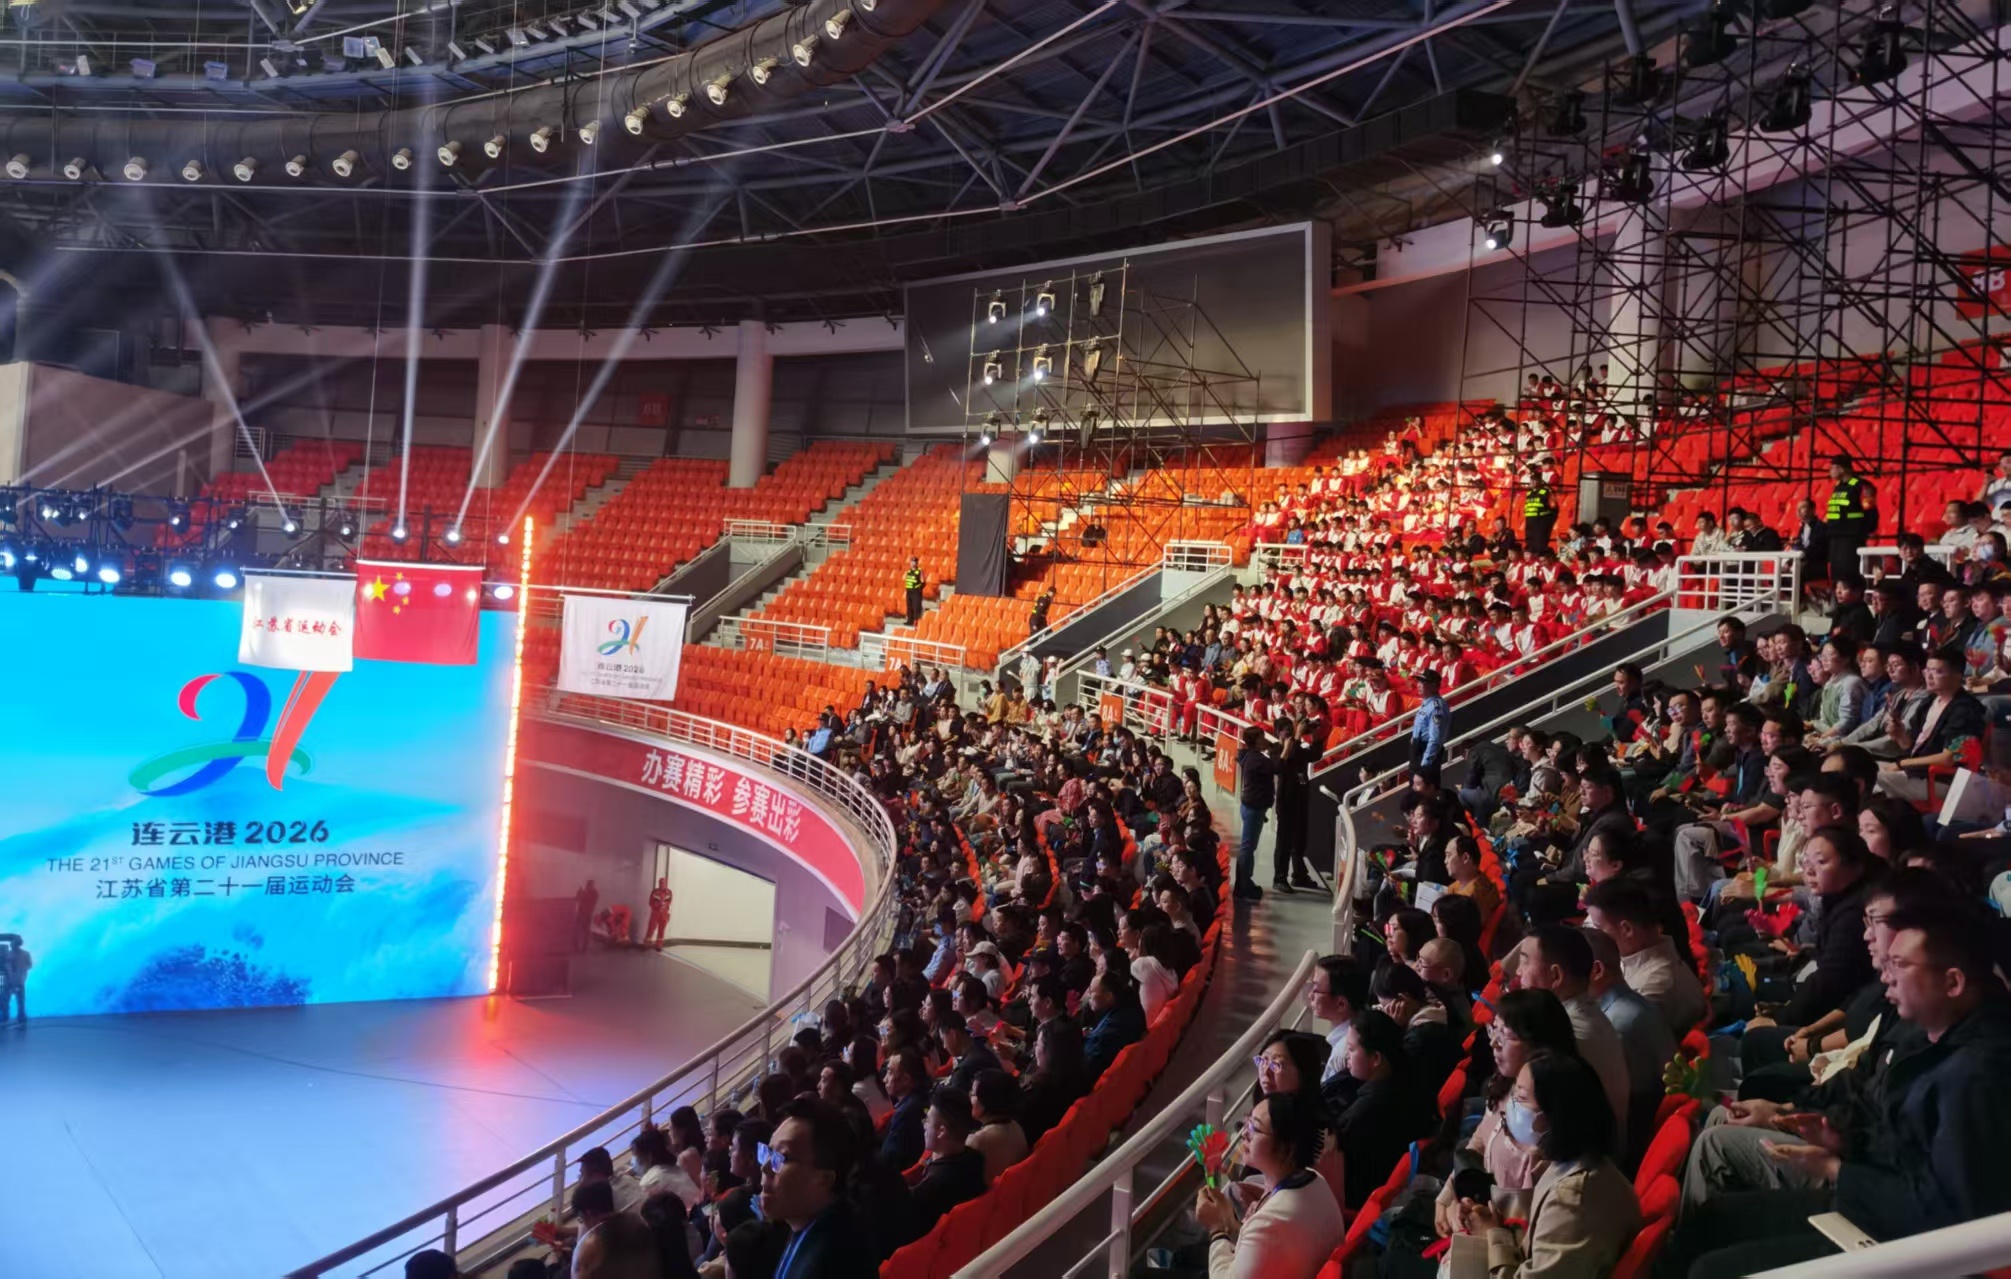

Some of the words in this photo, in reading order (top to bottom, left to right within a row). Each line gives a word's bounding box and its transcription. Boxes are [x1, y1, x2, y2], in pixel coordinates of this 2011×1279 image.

[750, 638, 763, 651] 7A
[641, 749, 725, 806] 办赛精彩
[731, 776, 801, 843] 参赛出彩
[131, 821, 236, 846] 连云港
[245, 820, 329, 844] 2026
[48, 858, 84, 872] THE
[129, 856, 195, 871] GAMES
[201, 855, 226, 870] OF
[231, 854, 309, 869] JIANGSU
[314, 852, 404, 867] PROVINCE
[96, 873, 355, 899] 江苏省第二十一届运动会
